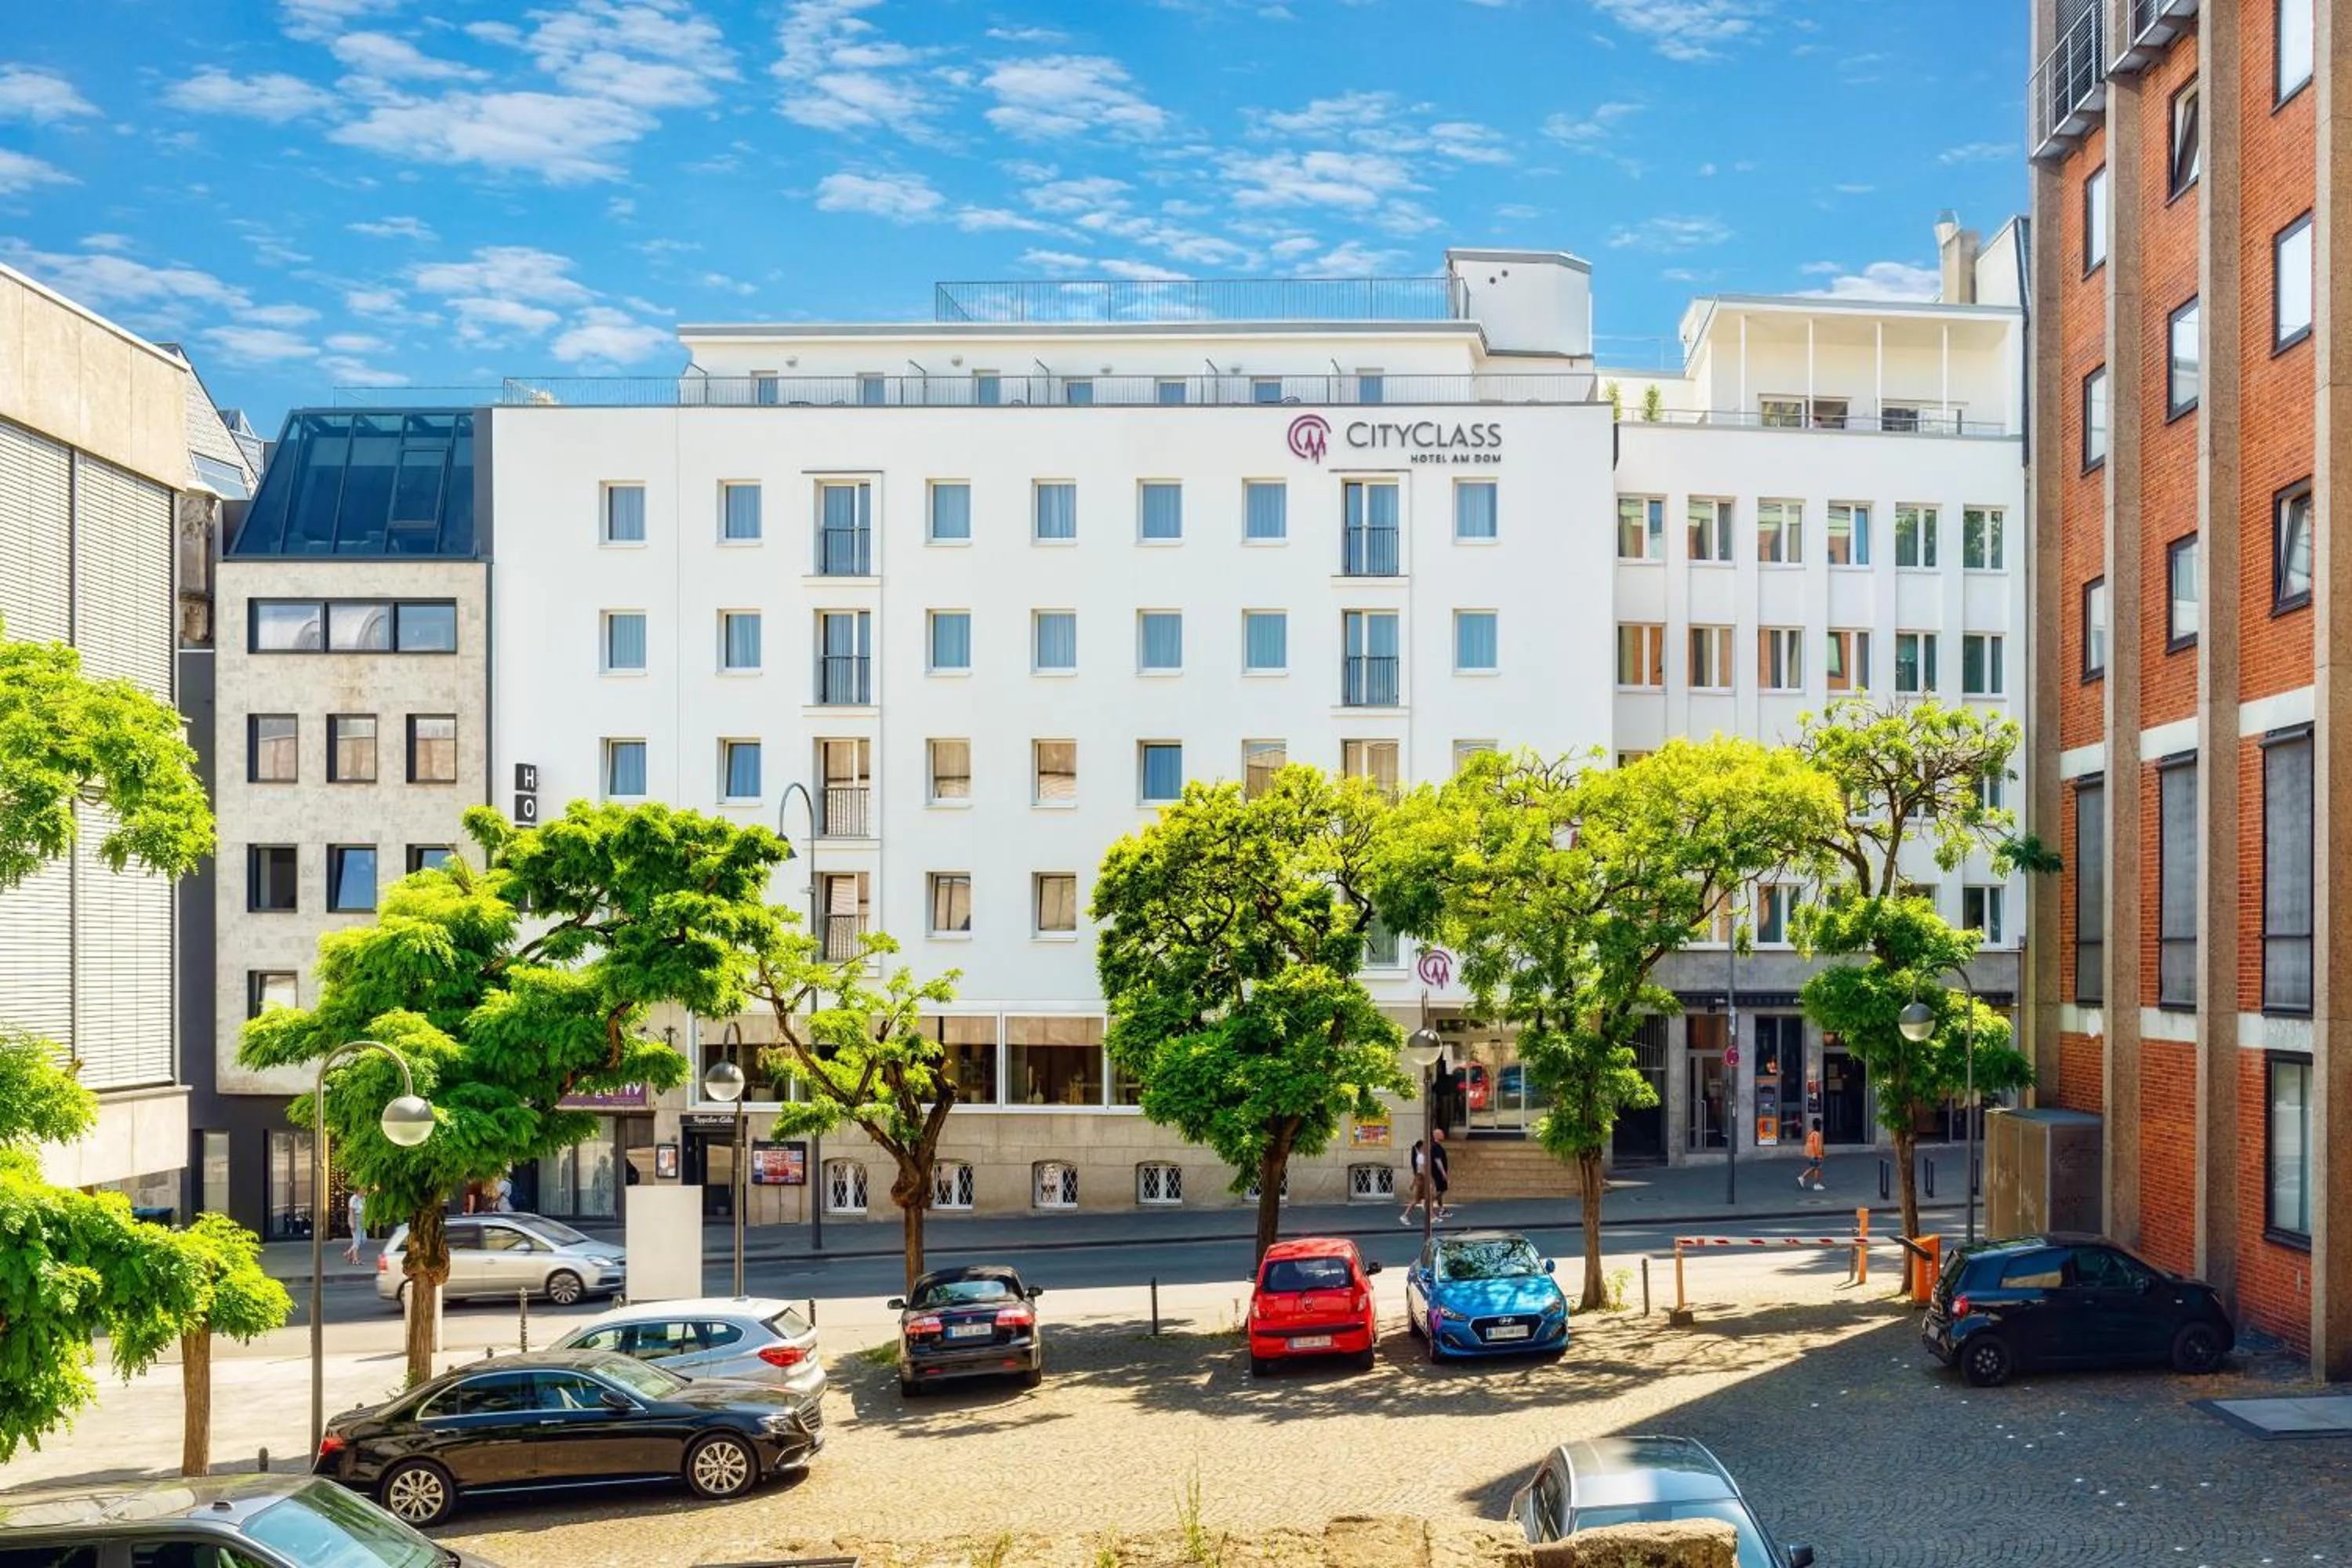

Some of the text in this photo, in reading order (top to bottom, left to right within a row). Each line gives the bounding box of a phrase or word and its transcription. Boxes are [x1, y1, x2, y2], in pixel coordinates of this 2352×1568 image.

[1346, 421, 1503, 448] CITYCLASS
[1410, 454, 1502, 463] HOTEL AM DOM
